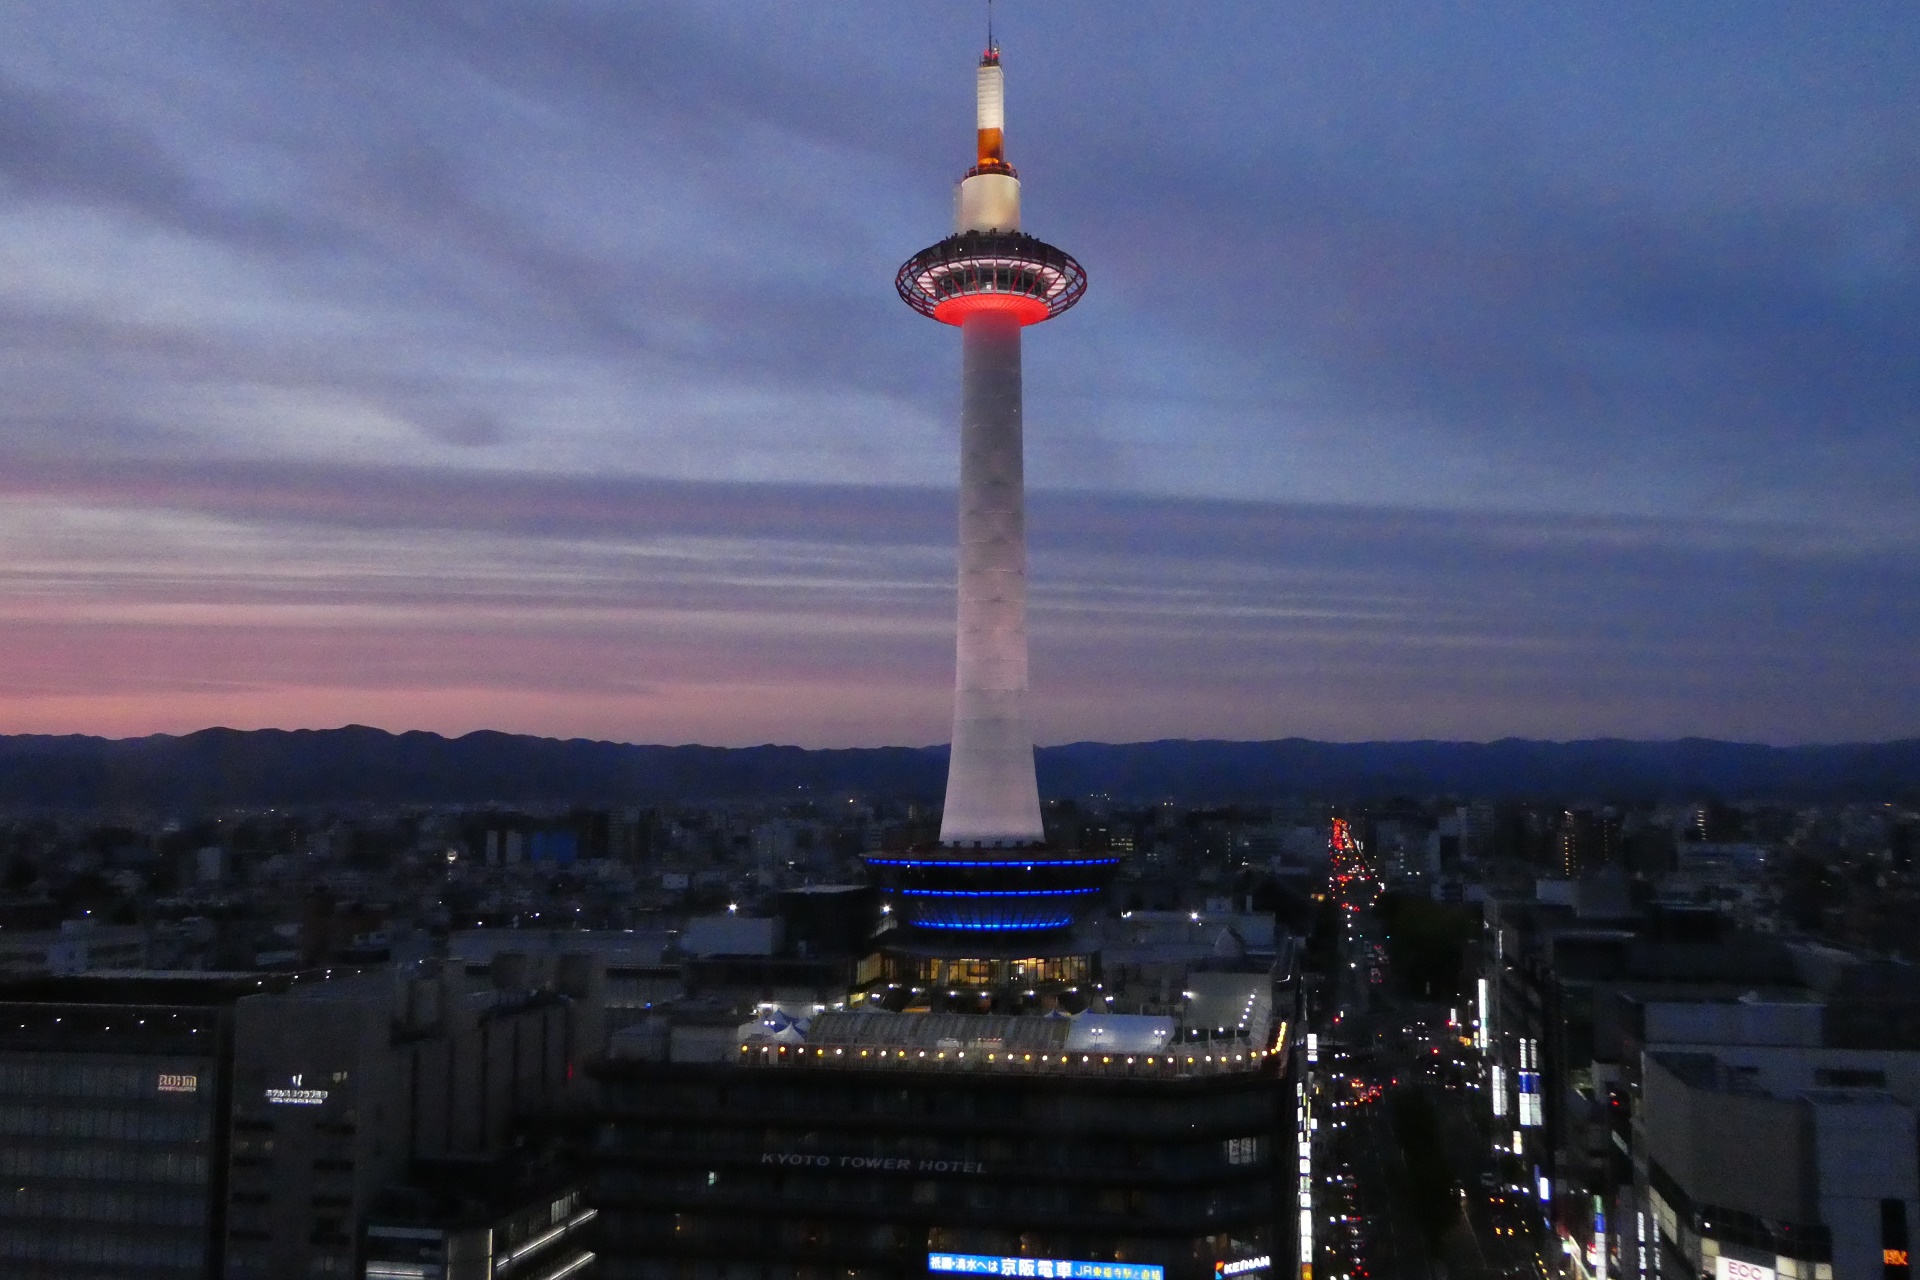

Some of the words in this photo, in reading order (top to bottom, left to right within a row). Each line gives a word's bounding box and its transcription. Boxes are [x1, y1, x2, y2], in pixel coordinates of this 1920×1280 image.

[761, 1153, 830, 1167] KYOTO
[839, 1156, 911, 1170] TOWER
[919, 1160, 987, 1174] HOTEL
[1224, 1256, 1270, 1274] KEIHAN
[1728, 1261, 1762, 1280] ECC
